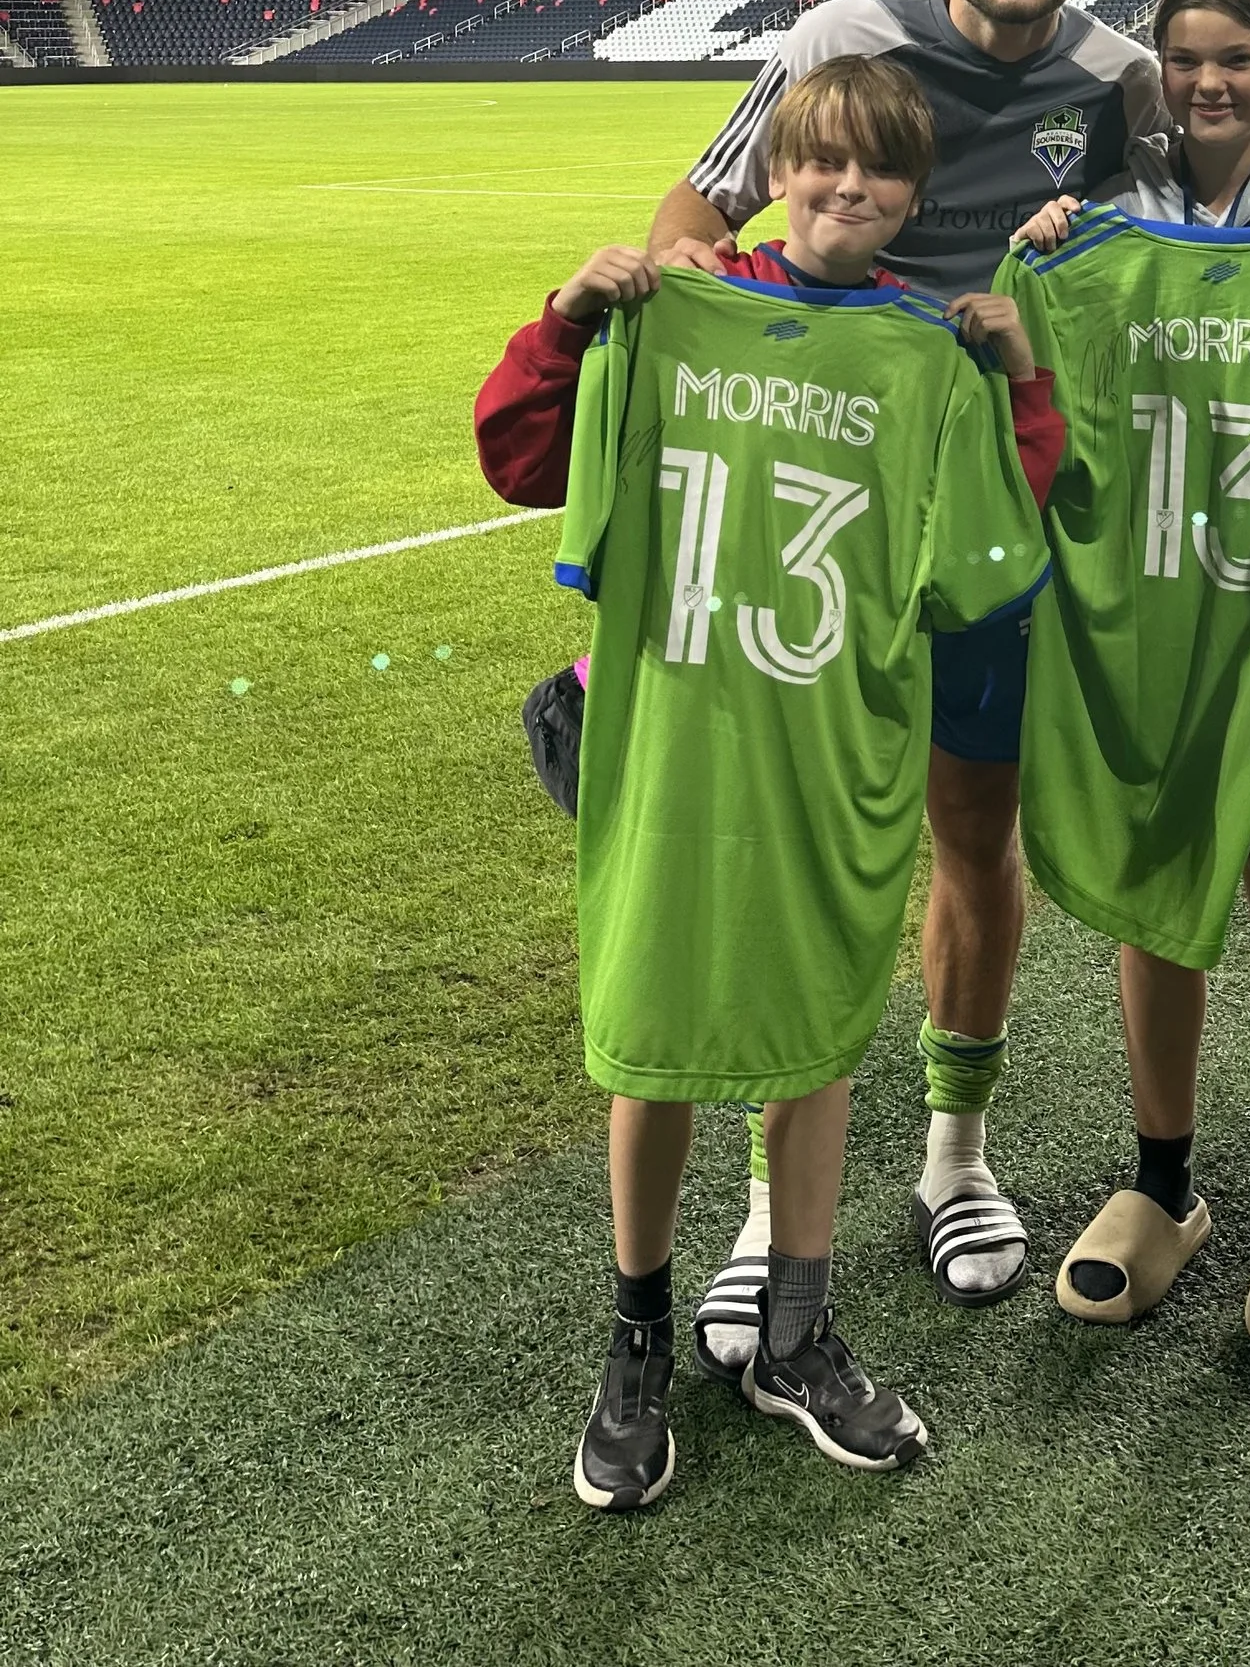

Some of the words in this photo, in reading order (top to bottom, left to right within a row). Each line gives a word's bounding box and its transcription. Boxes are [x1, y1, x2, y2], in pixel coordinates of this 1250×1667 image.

[1036, 135, 1073, 145] SOUNDERS
[674, 362, 880, 446] MORRIS
[659, 447, 870, 685] 13
